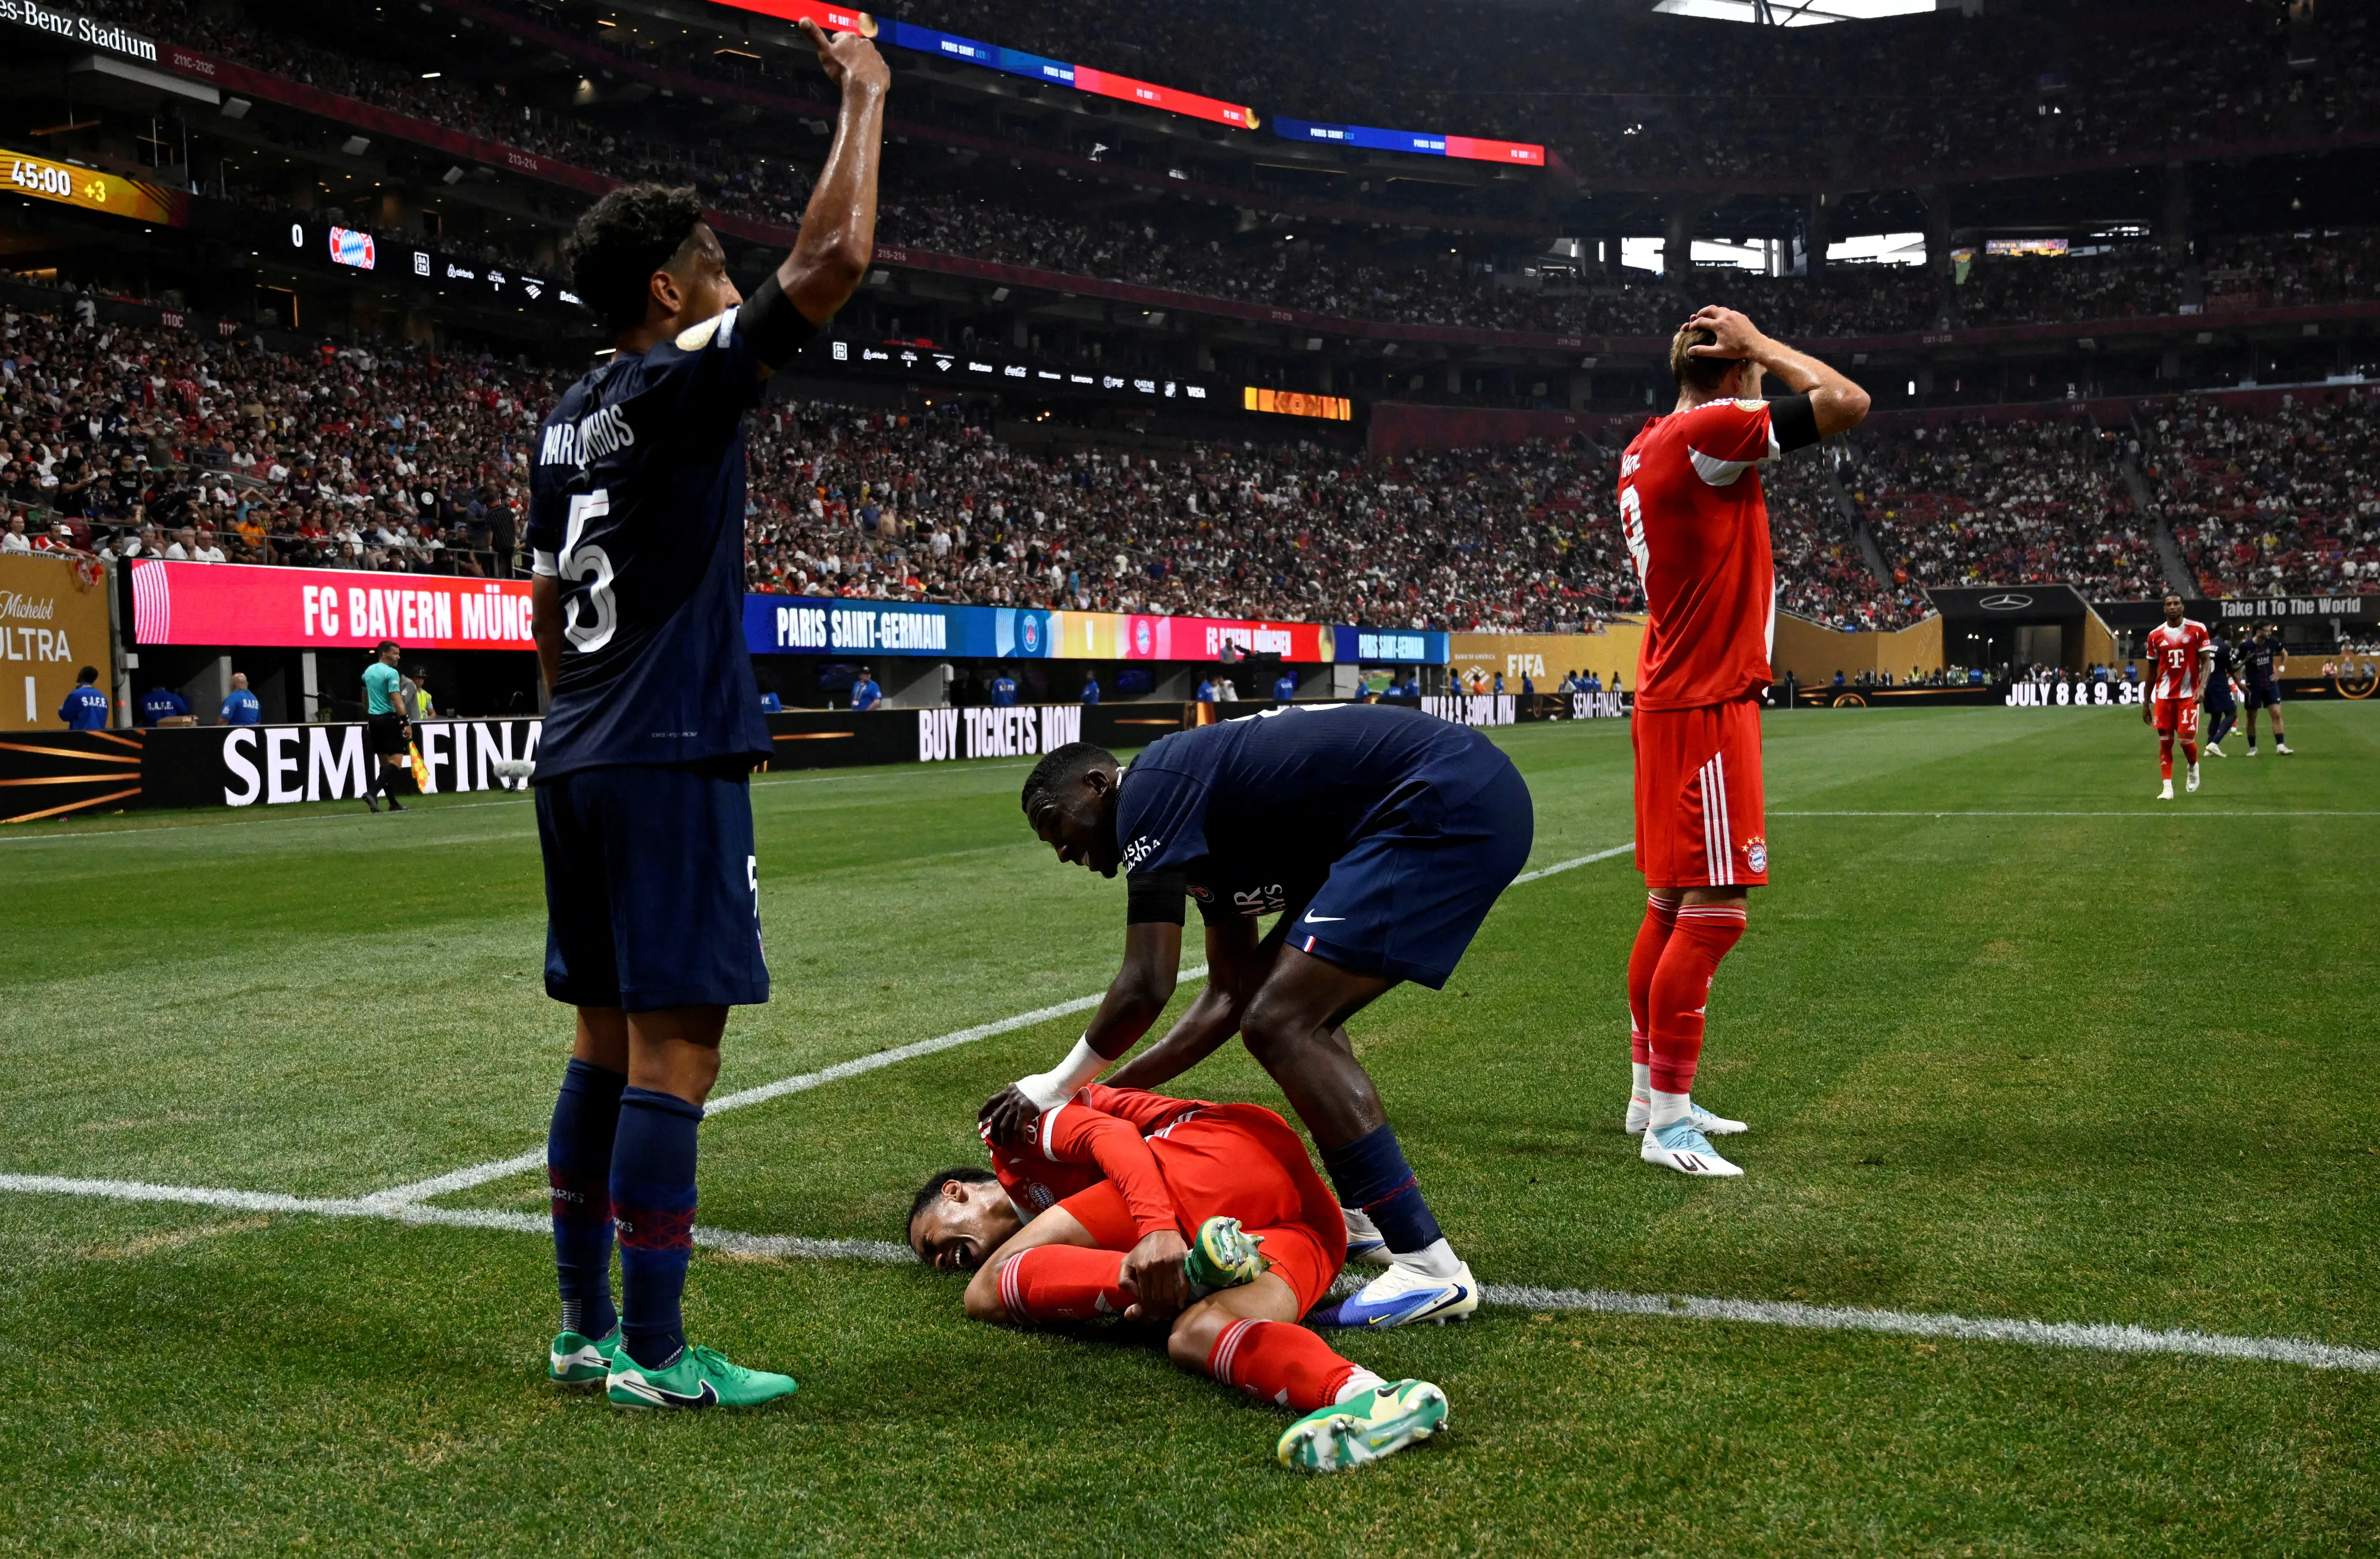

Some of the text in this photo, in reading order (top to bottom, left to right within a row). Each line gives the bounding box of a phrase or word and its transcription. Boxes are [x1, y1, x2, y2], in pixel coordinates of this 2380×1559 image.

[829, 13, 837, 23] FC
[79, 17, 157, 61] Stadium
[941, 40, 958, 53] PARIS
[174, 54, 215, 75] 211C-212C
[1044, 65, 1059, 77] PARIS
[1310, 128, 1327, 137] PARIS
[1414, 139, 1429, 149] PARIS
[508, 152, 537, 171] 213-214
[12, 160, 106, 202] 45:00 +3
[292, 224, 303, 247] 0
[878, 249, 907, 261] 215-216
[456, 268, 475, 279] airbnb
[488, 274, 506, 283] ULTRA
[162, 313, 184, 328] 110C
[1112, 378, 1125, 388] PIF
[1186, 386, 1206, 399] VISA
[558, 489, 618, 653] 5
[0, 591, 54, 620] Michelob
[302, 585, 340, 637] FC
[349, 587, 452, 639] BAYERN
[2221, 596, 2361, 617] Take It To The World
[776, 606, 946, 650] PARIS SAINT-GERMAIN
[1206, 627, 1218, 655] FC
[1359, 634, 1424, 660] PARIS SAINT-GERMAIN
[1507, 654, 1546, 678] FIFA
[82, 696, 108, 708] S.A.F.E.
[2005, 683, 2051, 707] JULY
[2056, 682, 2069, 706] 8
[2074, 682, 2088, 706] &
[148, 701, 174, 711] S.A.F.E.
[1573, 692, 1623, 720] SEMI-FINALS
[2181, 709, 2197, 724] 17
[919, 706, 1082, 762] BUY TICKETS NOW
